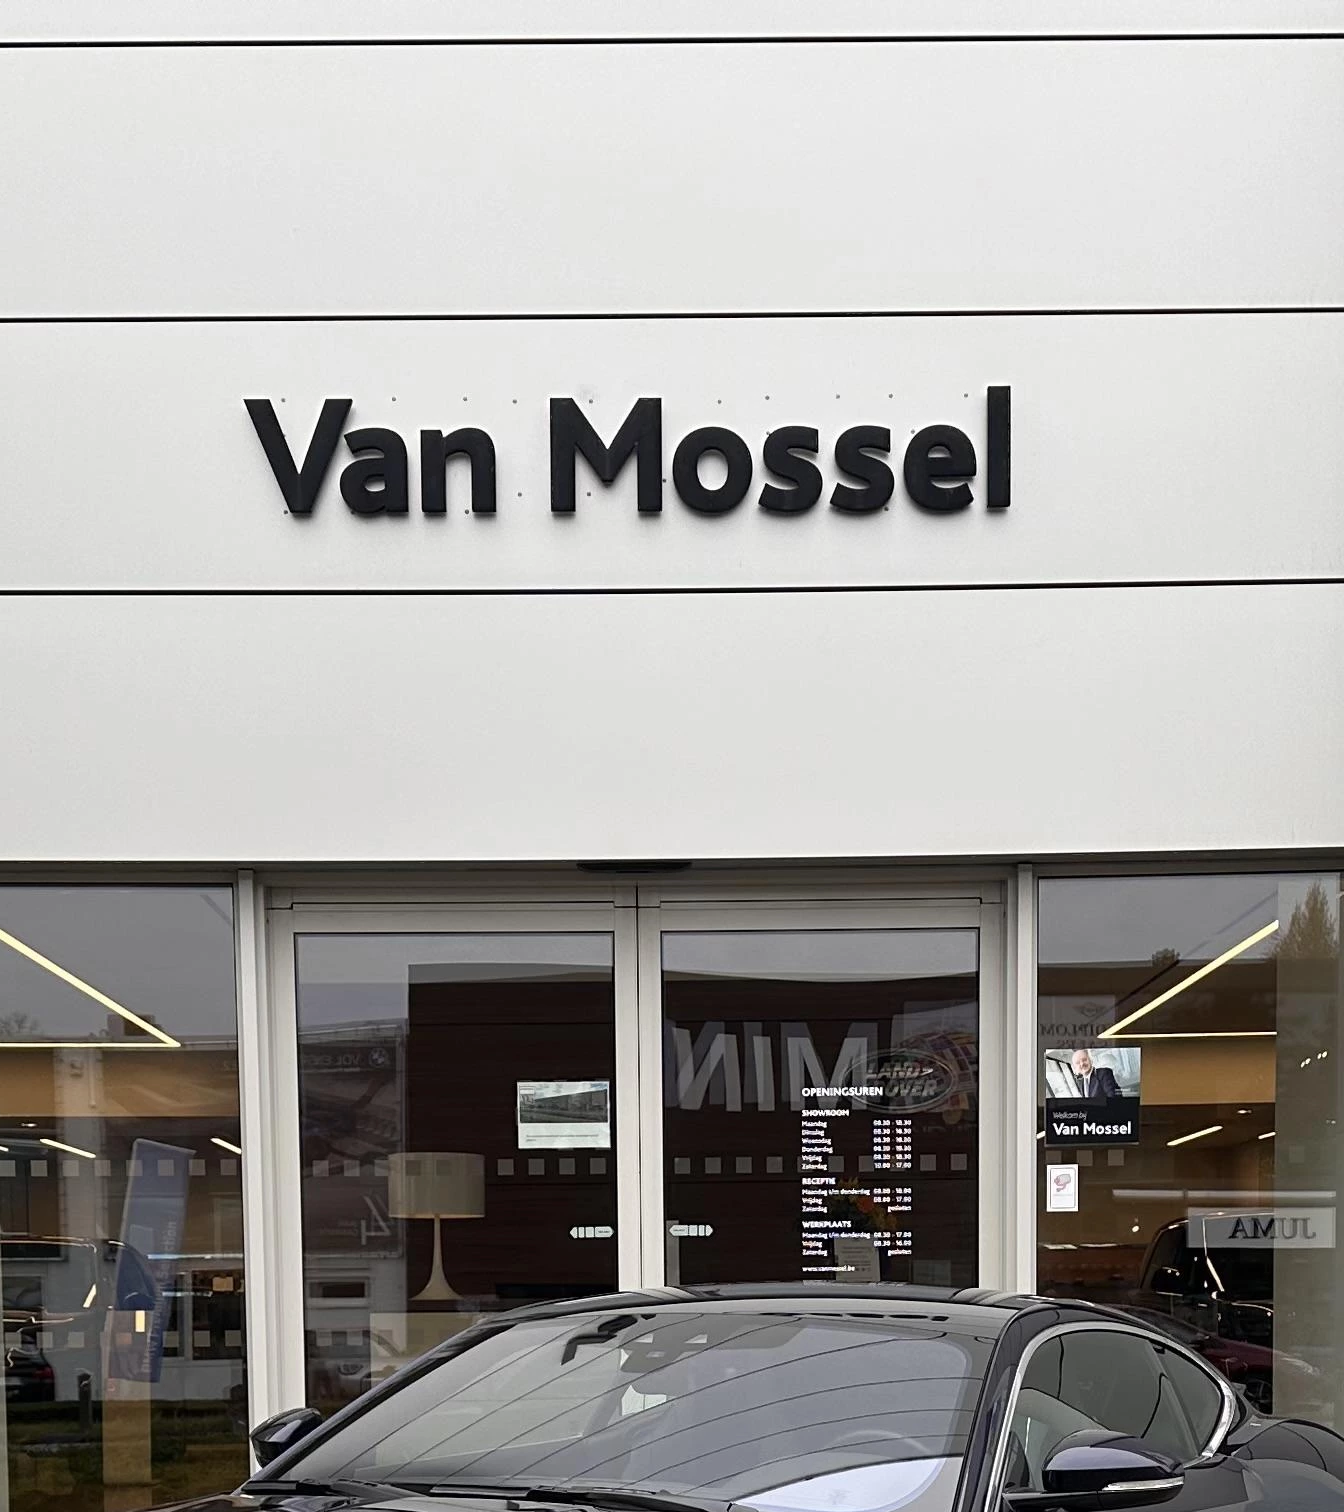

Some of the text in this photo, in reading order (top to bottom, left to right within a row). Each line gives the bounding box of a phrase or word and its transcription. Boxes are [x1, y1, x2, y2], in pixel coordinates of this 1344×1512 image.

[243, 385, 1012, 514] Van Mossel
[801, 1086, 884, 1097] OPENINGSUREN
[801, 1109, 850, 1117] SHOWROOM
[1052, 1121, 1132, 1136] Van Mossel
[801, 1220, 852, 1228] WERKPLAATS
